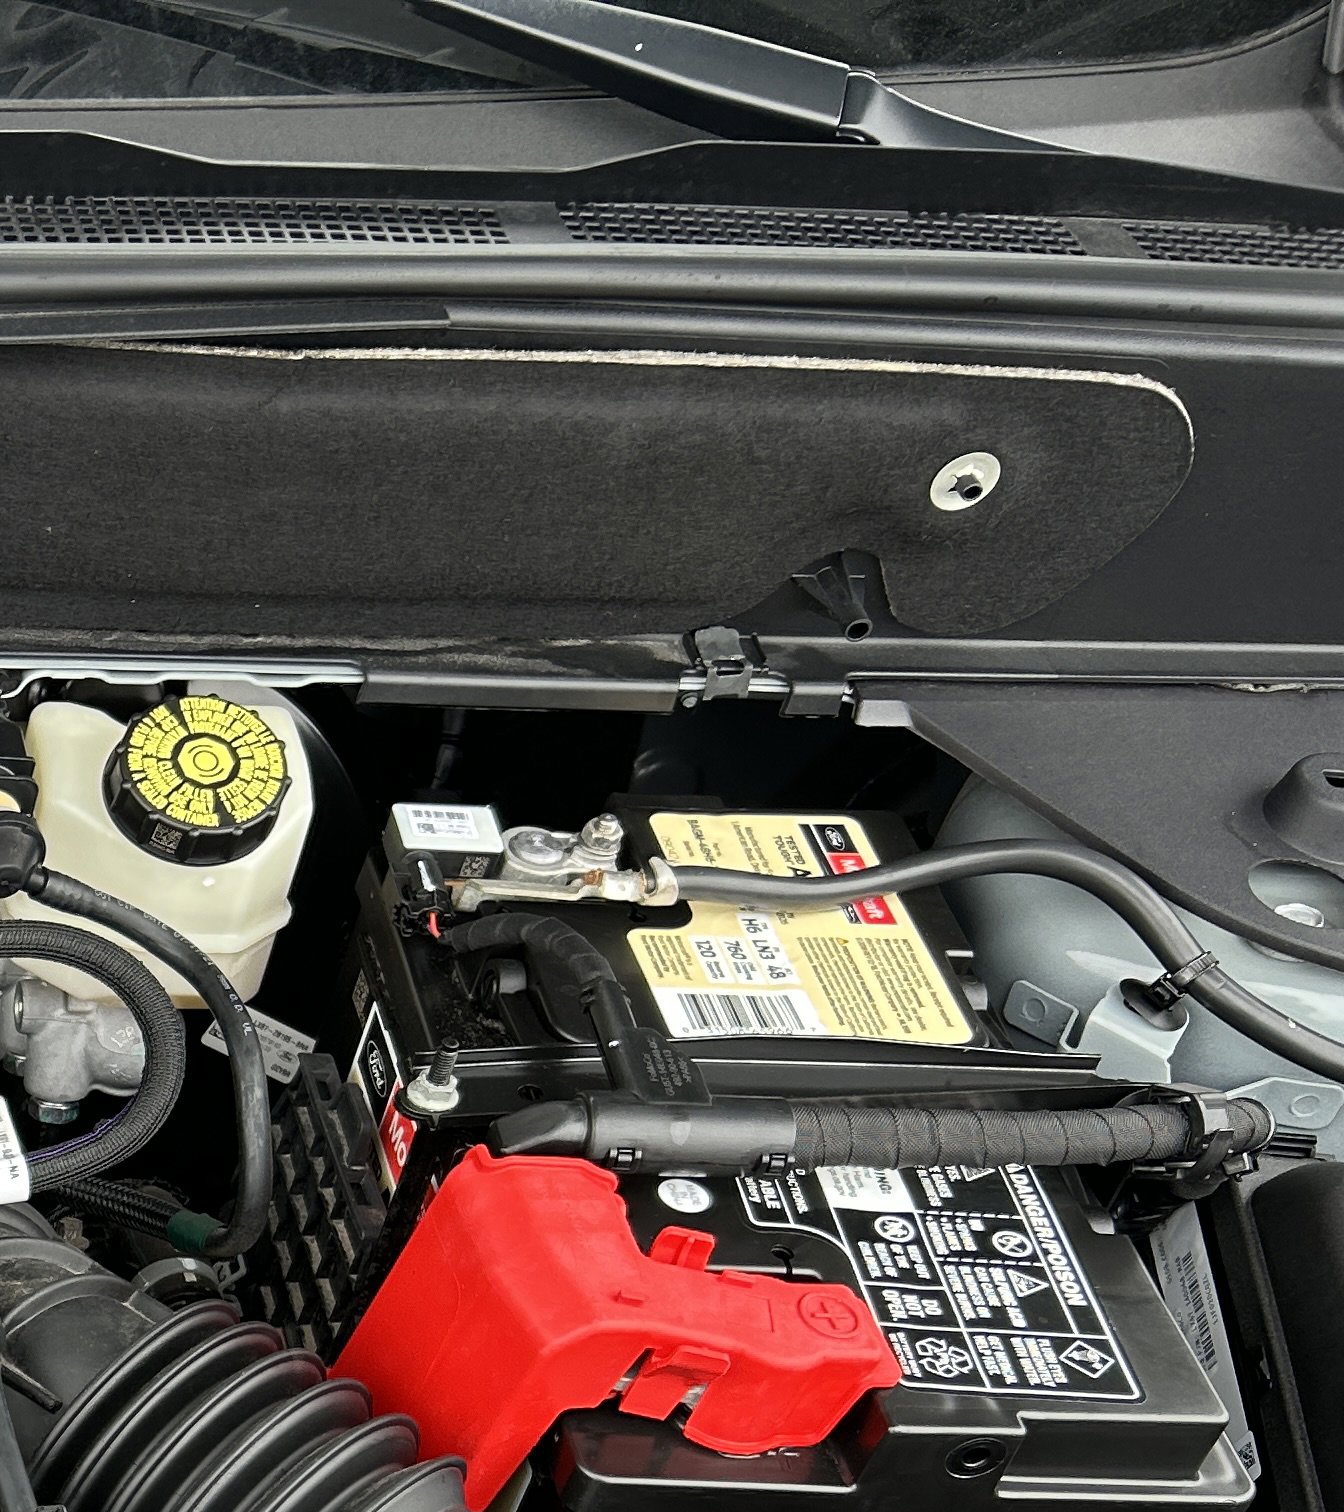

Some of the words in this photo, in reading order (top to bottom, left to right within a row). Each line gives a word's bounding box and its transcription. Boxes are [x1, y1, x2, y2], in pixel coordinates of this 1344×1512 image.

[157, 714, 180, 732] CAP
[178, 698, 227, 713] ATTENTION
[259, 729, 278, 743] LE
[129, 722, 152, 747] FLUID
[128, 747, 144, 771] FROM
[131, 772, 147, 781] A
[158, 760, 183, 788] CLEAN
[177, 782, 215, 801] FILLER
[135, 780, 169, 810] SEALED
[166, 790, 190, 809] USE
[229, 792, 251, 809] DOT
[164, 803, 220, 826] CONTAINER
[188, 799, 215, 814] ONLY
[782, 835, 807, 864] TESTED
[740, 917, 763, 933] H6
[694, 939, 717, 958] 120
[723, 940, 747, 960] 760
[751, 938, 776, 960] LN3
[764, 964, 787, 979] 48
[888, 1244, 905, 1254] OF
[1006, 1173, 1088, 1306] DANGER/POISON
[882, 1266, 898, 1277] OF
[972, 1266, 991, 1281] CAN
[879, 1289, 909, 1321] OPEN.
[900, 1294, 927, 1318] NOT
[919, 1298, 944, 1315] DO
[971, 1335, 993, 1355] HELP
[1008, 1337, 1030, 1357] WITH
[1035, 1338, 1060, 1363] FLUSH
